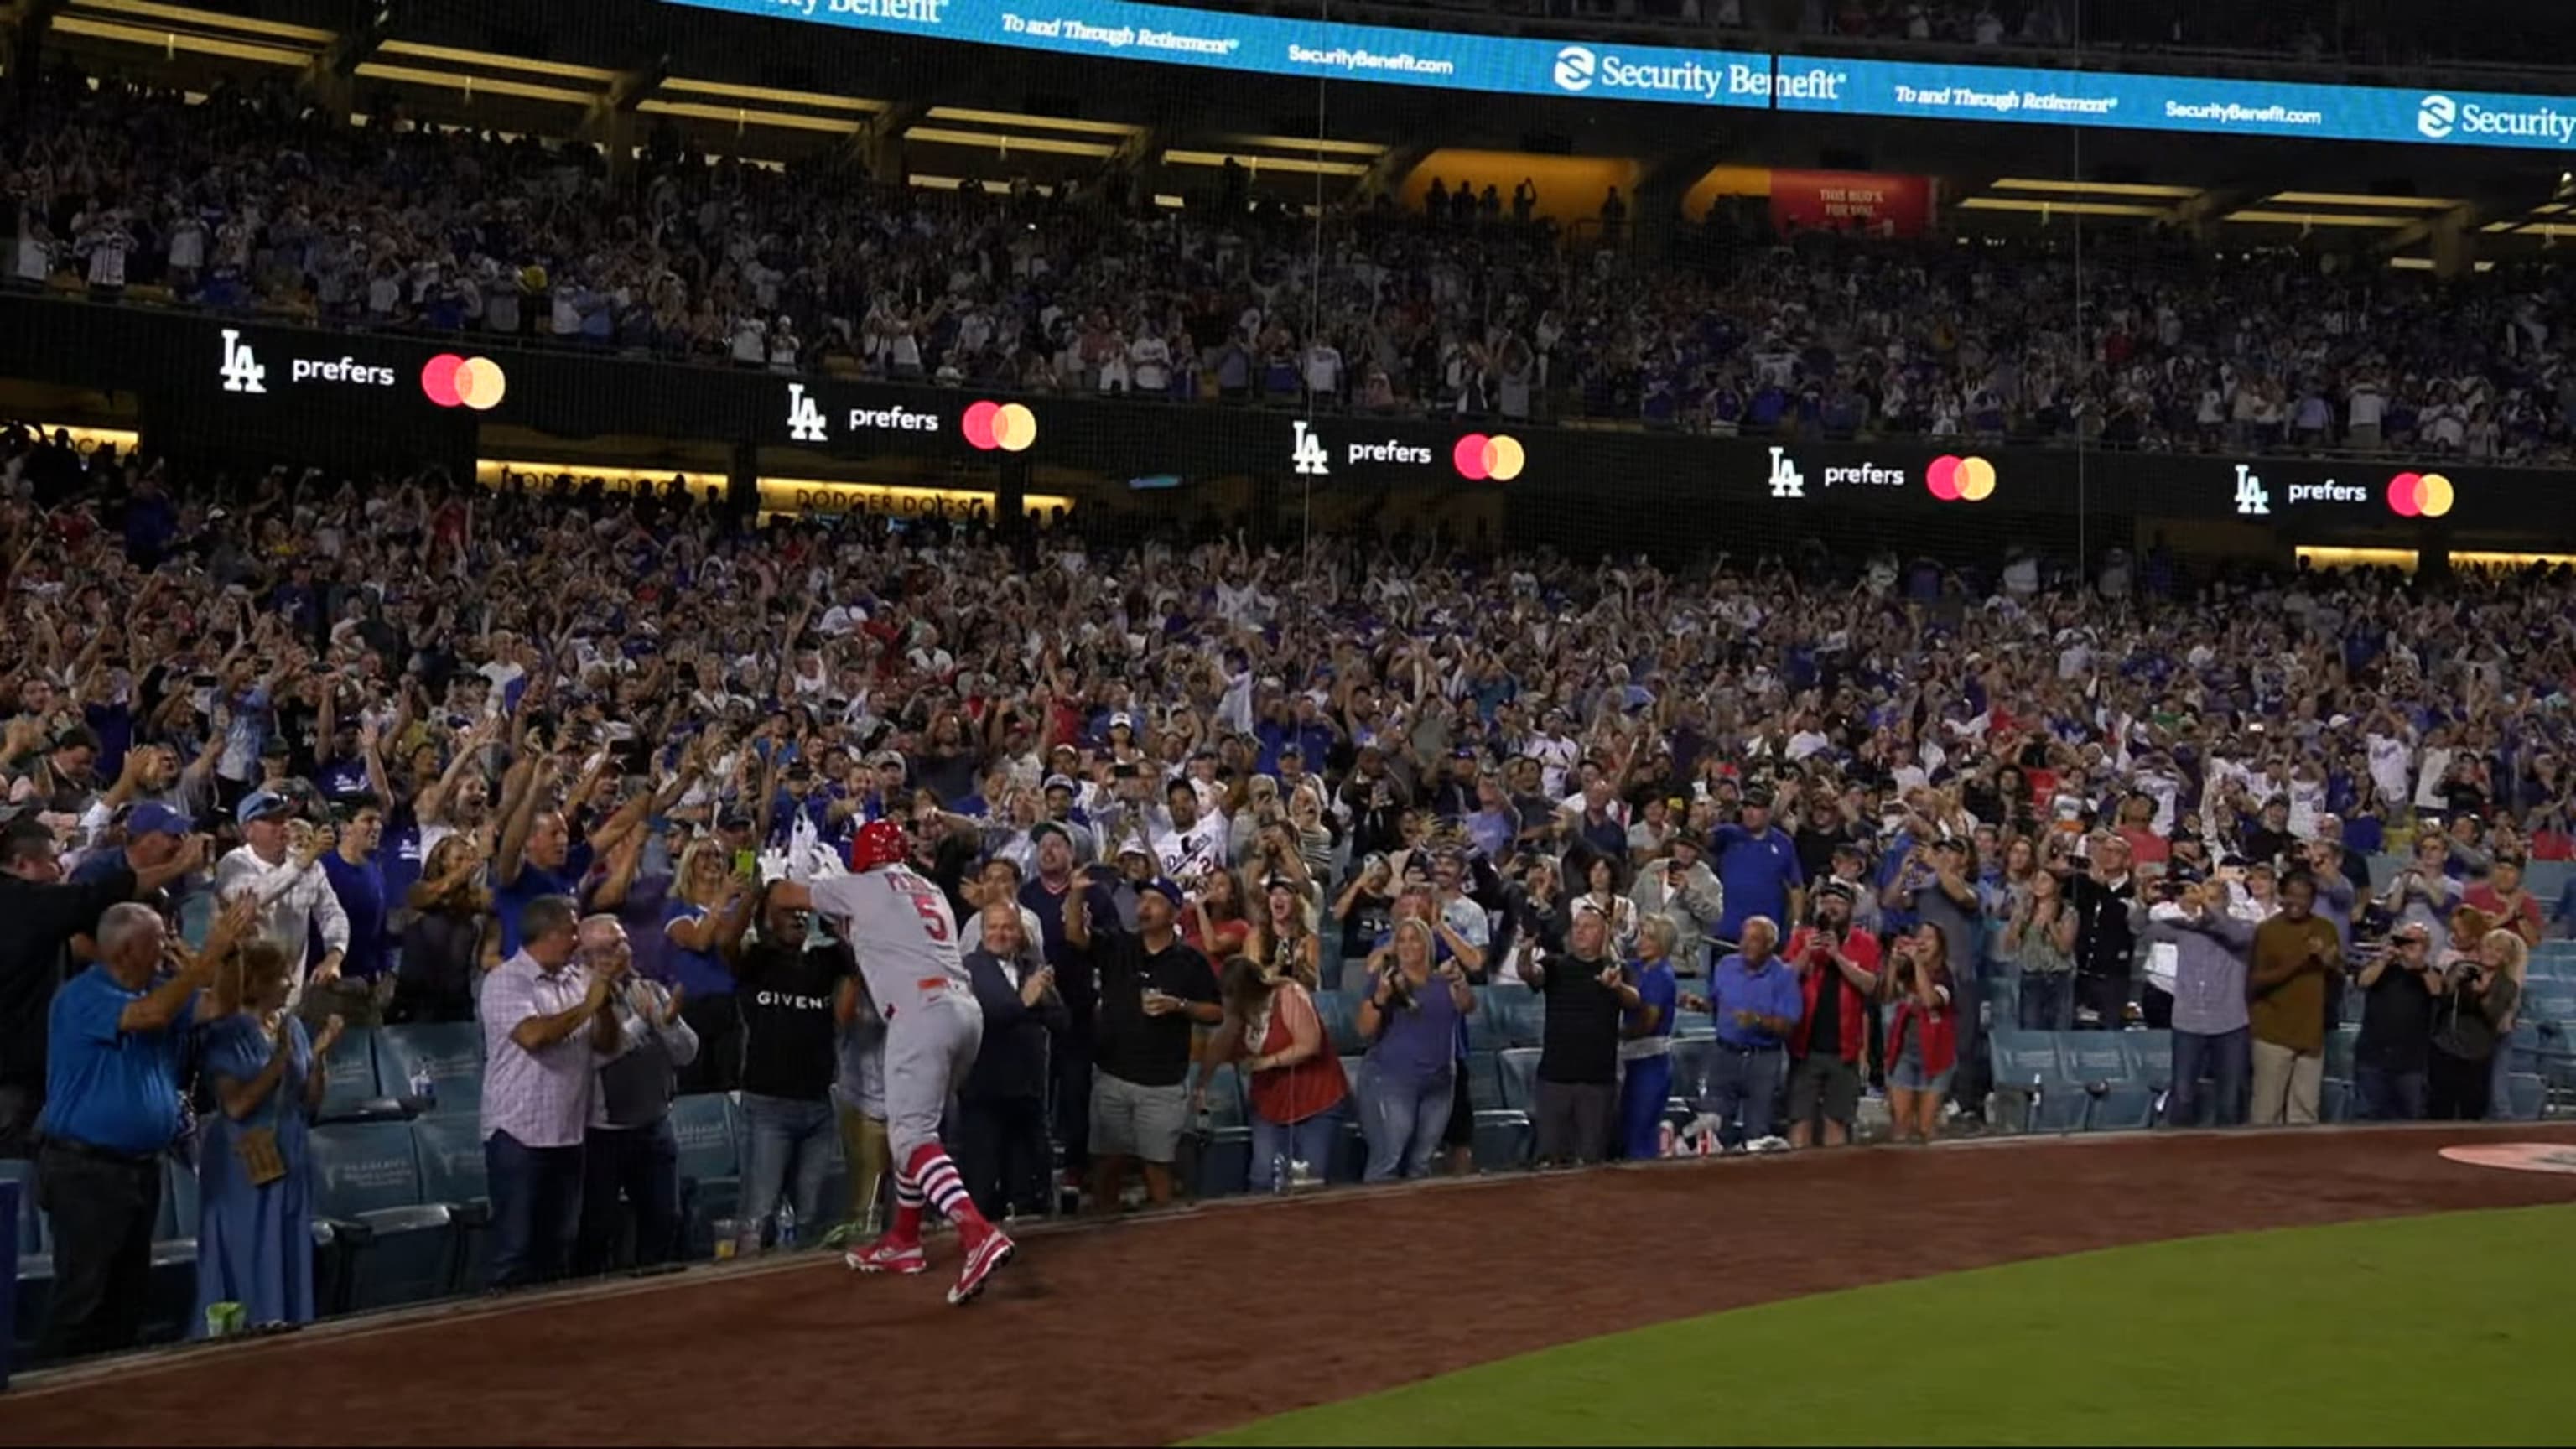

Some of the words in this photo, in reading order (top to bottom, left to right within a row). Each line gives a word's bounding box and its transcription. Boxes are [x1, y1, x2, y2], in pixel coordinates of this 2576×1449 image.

[1002, 13, 1025, 32] To
[1026, 18, 1061, 37] and
[1062, 21, 1135, 47] Through
[1136, 29, 1230, 54] Retirement
[1289, 44, 1454, 75] SecurityBenefit.com
[1602, 55, 1722, 99] Security
[1729, 64, 1840, 100] Benefit
[1895, 85, 1916, 103] To
[1918, 87, 1950, 106] and
[1952, 88, 2021, 112] Through
[2022, 92, 2109, 113] Retirement
[2165, 100, 2322, 125] SecurityBenefit.com
[2462, 103, 2576, 143] Security
[219, 329, 267, 393] LA
[293, 356, 395, 386] prefers
[787, 383, 828, 441] LA
[849, 405, 938, 431] prefers
[1291, 420, 1329, 475] LA
[1348, 439, 1431, 465] prefers
[1768, 446, 1805, 497] LA
[1824, 462, 1904, 486] prefers
[2234, 464, 2270, 514] LA
[2288, 479, 2367, 503] prefers
[912, 894, 948, 942] 5
